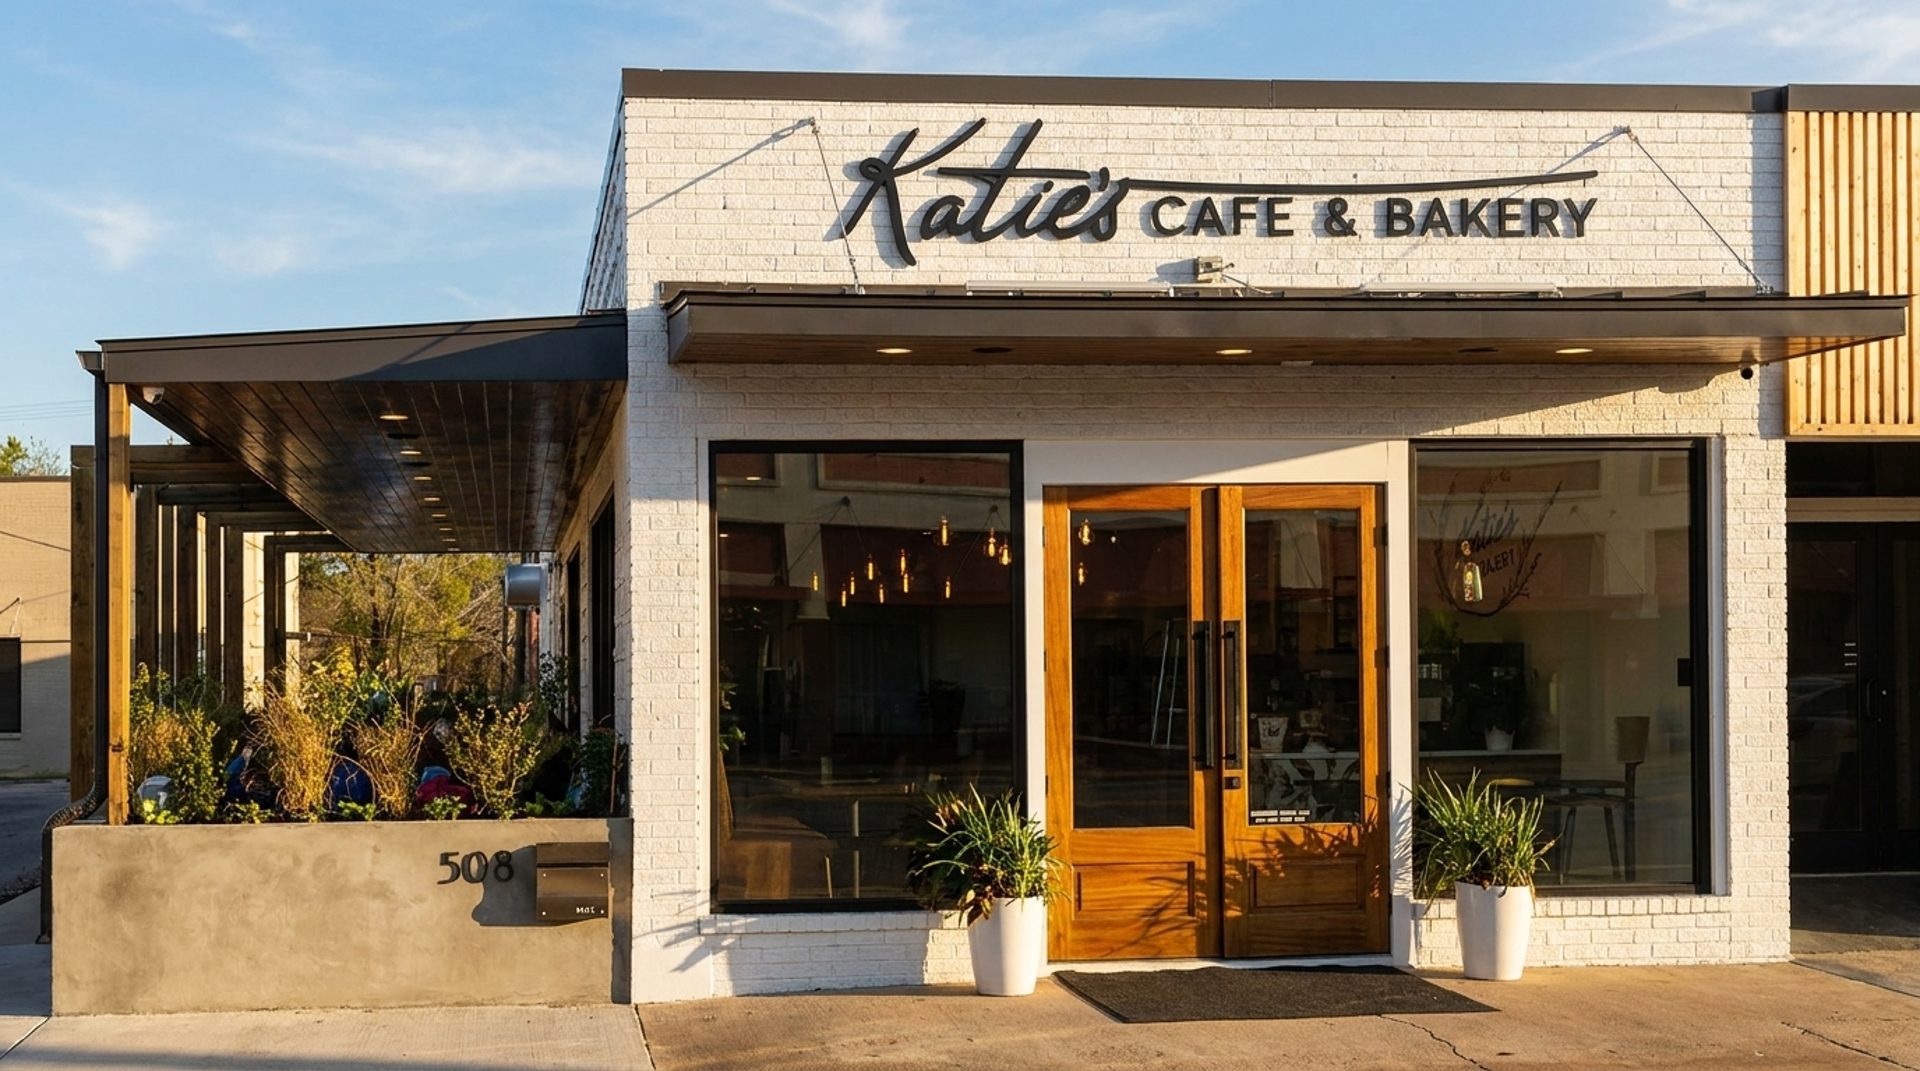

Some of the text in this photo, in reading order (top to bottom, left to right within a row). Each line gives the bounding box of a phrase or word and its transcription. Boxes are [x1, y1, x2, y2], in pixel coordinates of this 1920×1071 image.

[843, 118, 1598, 266] Katie's CAFE & BAKERY
[437, 850, 514, 884] 508
